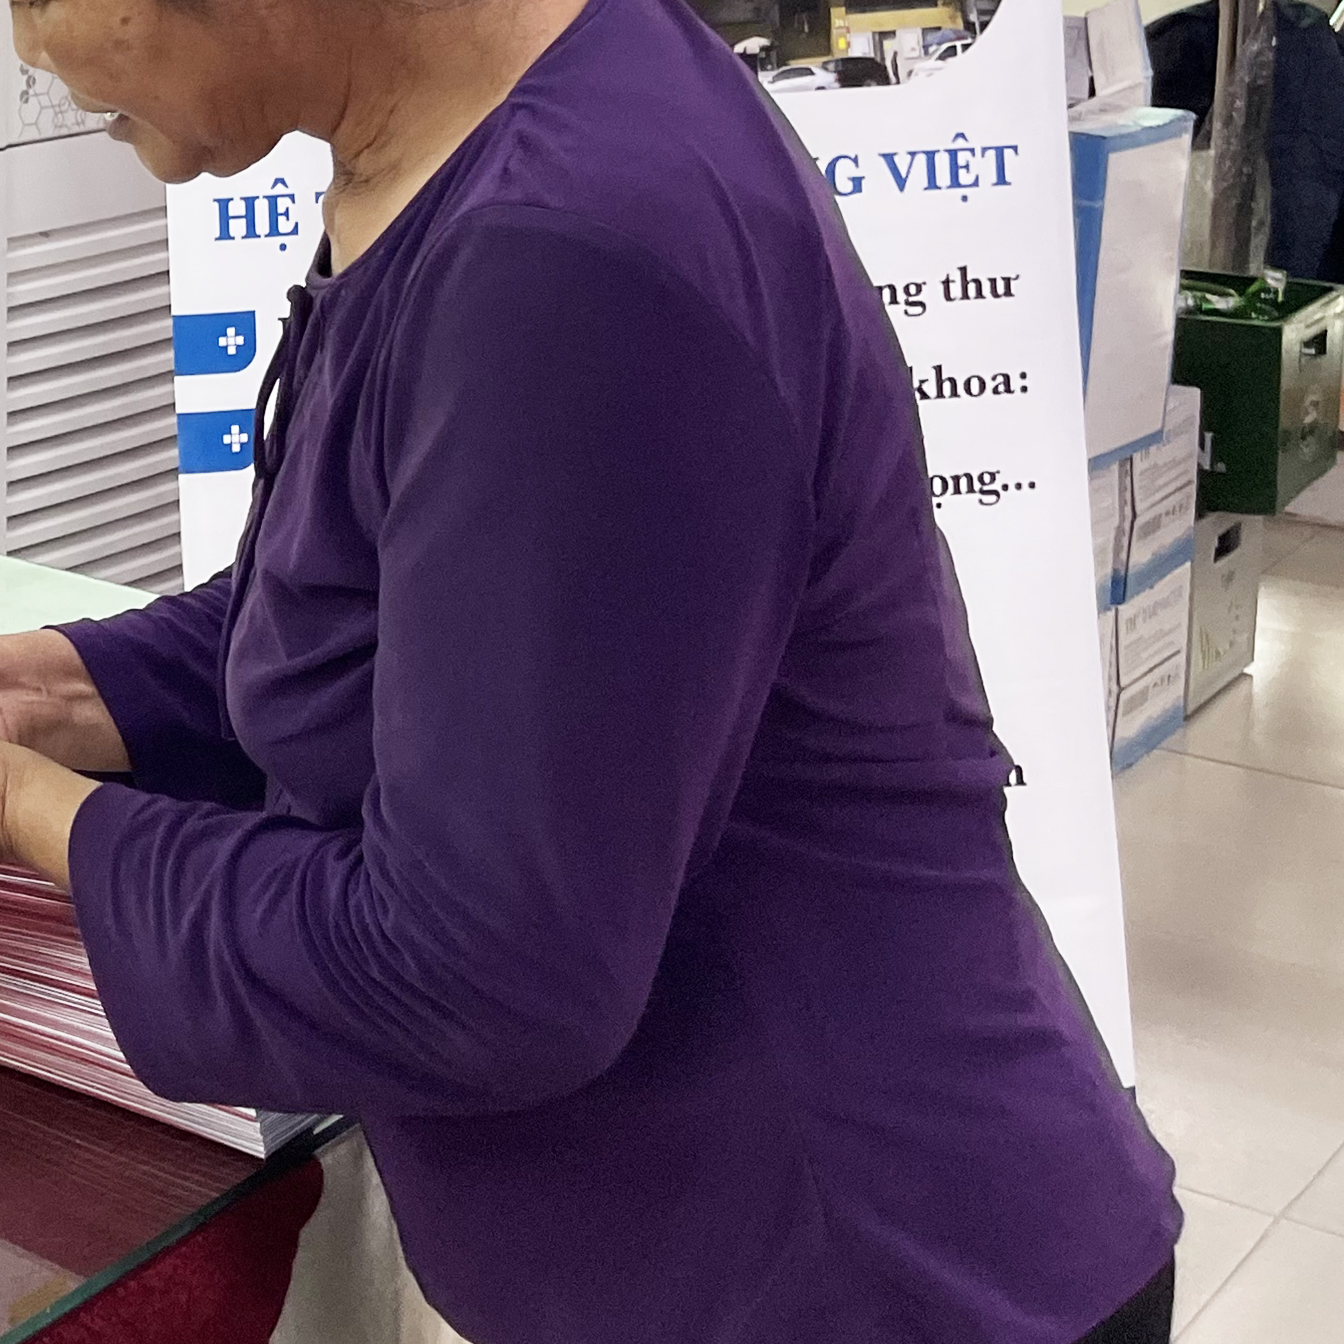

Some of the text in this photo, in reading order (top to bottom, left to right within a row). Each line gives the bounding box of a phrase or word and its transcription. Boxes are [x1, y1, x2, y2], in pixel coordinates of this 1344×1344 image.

[212, 177, 300, 252] HỆ
[878, 131, 1019, 203] VIỆT
[940, 264, 1021, 304] thư
